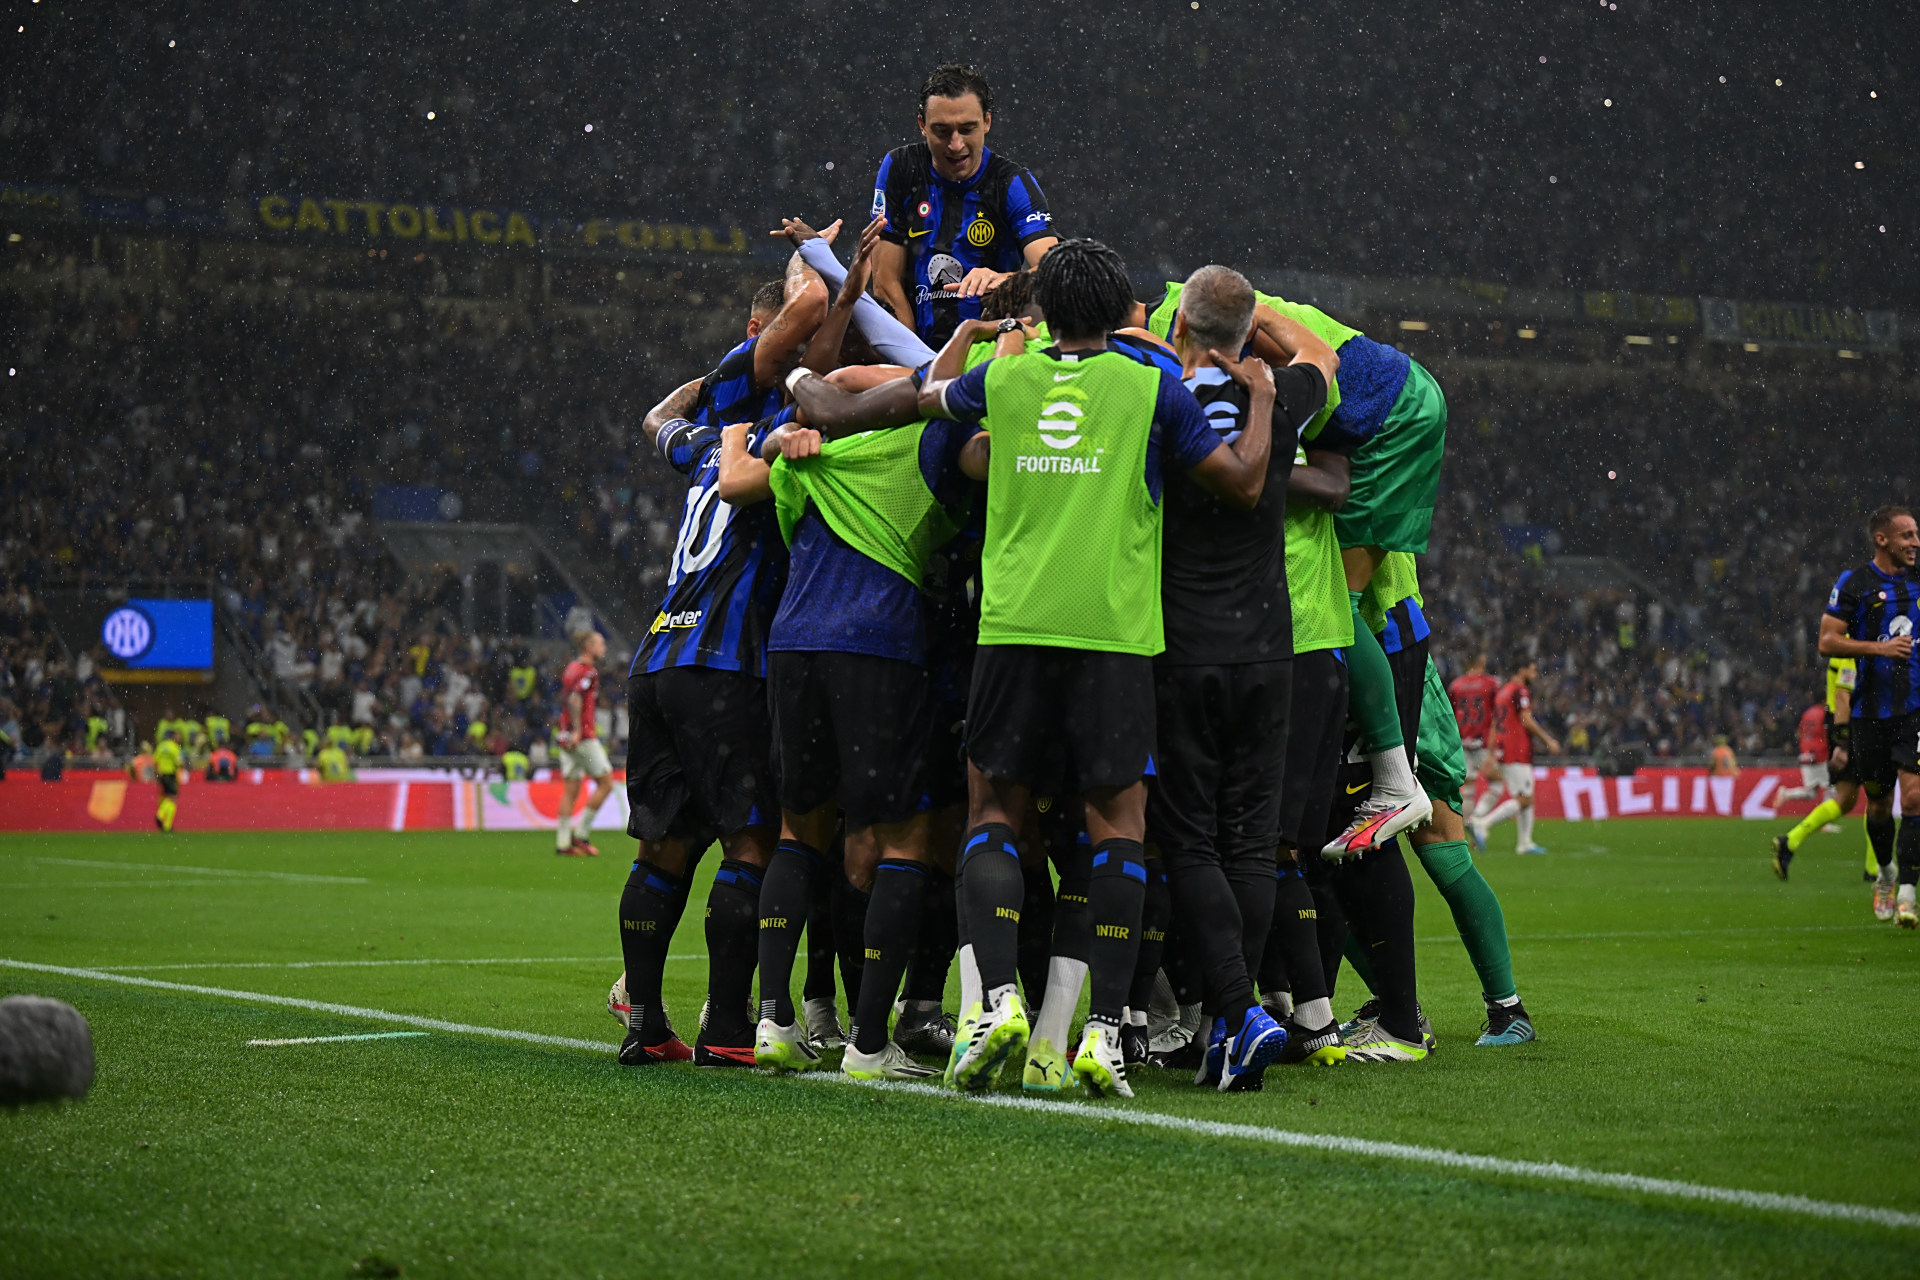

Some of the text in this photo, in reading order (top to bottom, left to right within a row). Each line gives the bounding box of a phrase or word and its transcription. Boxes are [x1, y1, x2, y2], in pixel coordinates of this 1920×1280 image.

[259, 195, 537, 248] CATTOLICA
[1016, 455, 1102, 475] FOOTBALL
[667, 482, 732, 587] 10
[1559, 775, 1781, 821] HEINZ
[624, 919, 657, 932] INTER
[1096, 924, 1130, 940] INTER
[1303, 1032, 1339, 1054] PUMA
